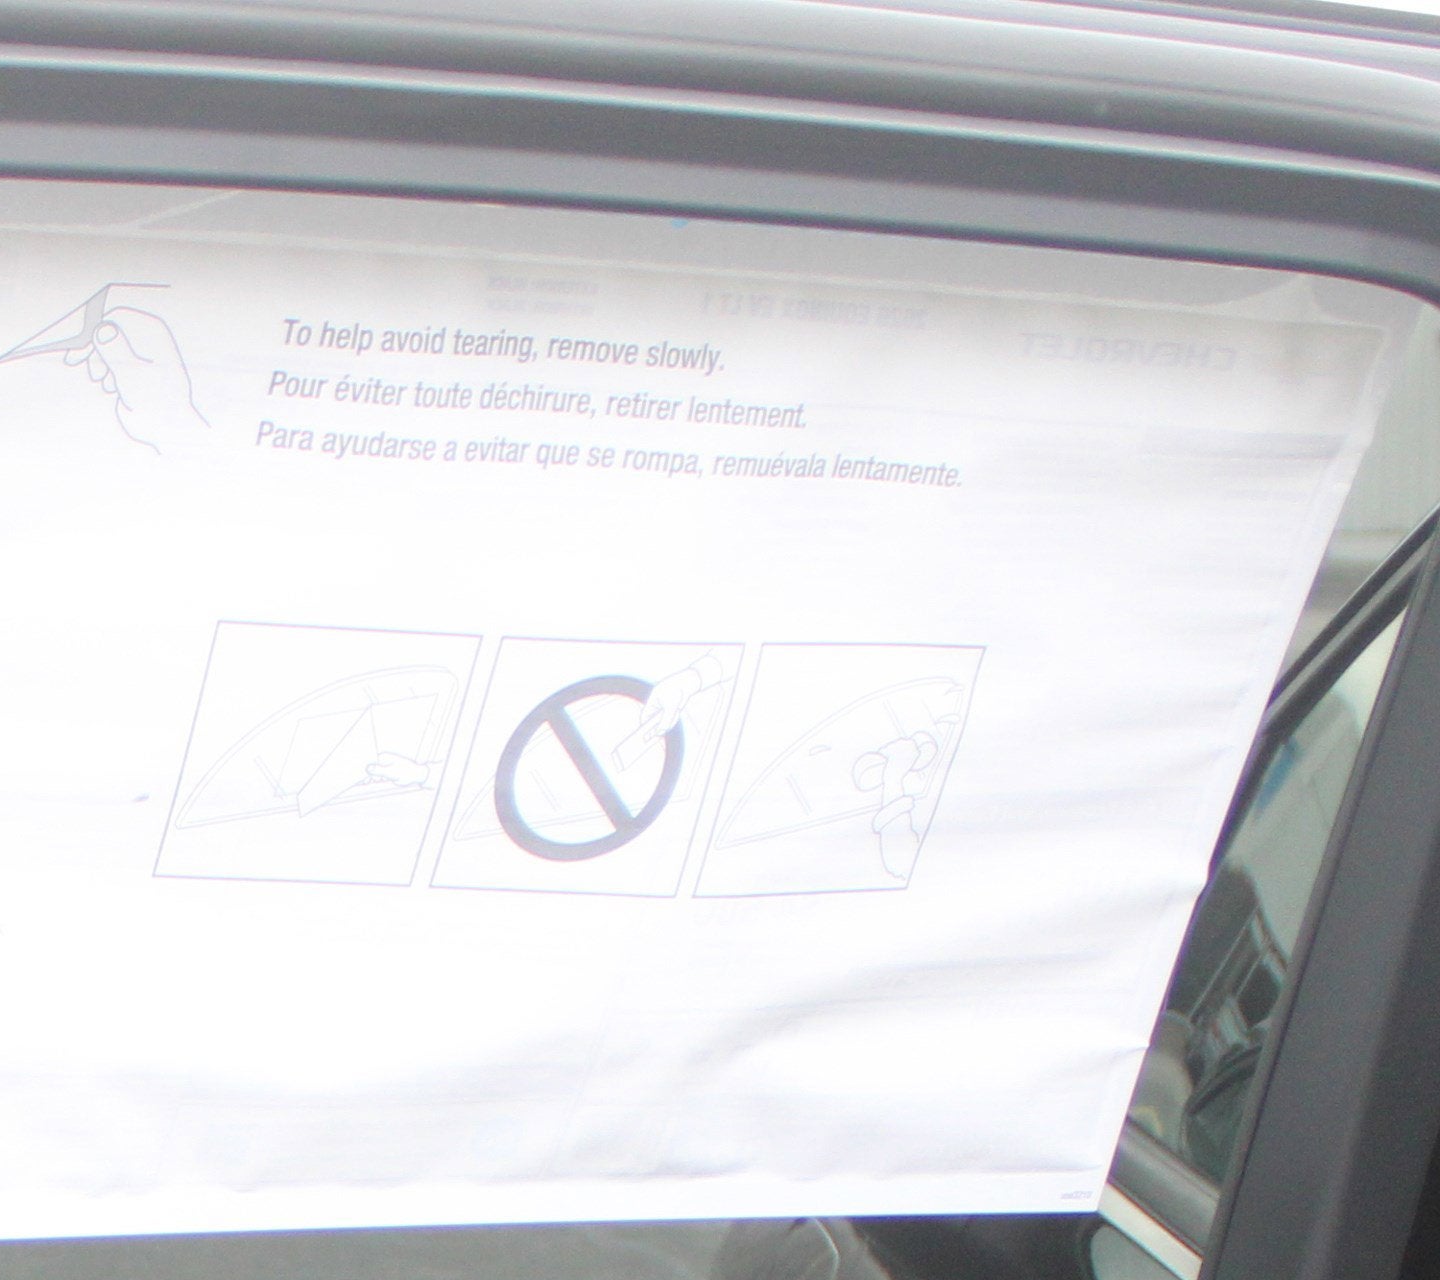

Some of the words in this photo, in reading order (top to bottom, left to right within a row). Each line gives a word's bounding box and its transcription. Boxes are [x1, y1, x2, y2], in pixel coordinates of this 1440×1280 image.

[282, 316, 312, 347] To
[319, 321, 374, 357] help
[380, 326, 447, 355] avoid
[453, 329, 538, 364] tearing,
[547, 336, 639, 366] remove
[644, 341, 725, 377] slowly.
[267, 369, 328, 400] Pour
[333, 374, 408, 407] éviter
[413, 381, 473, 410] toute
[479, 382, 597, 419] déchirure,
[605, 391, 682, 421] retirer
[687, 396, 808, 429] lentement.
[255, 419, 314, 452] Para
[321, 430, 437, 462] ayudarse
[442, 439, 458, 462] a
[463, 436, 529, 464] evitar
[535, 445, 580, 471] que
[586, 446, 616, 469] se
[622, 448, 704, 479] rompa,
[711, 450, 827, 479] remuévala
[831, 454, 963, 488] lentamente.
